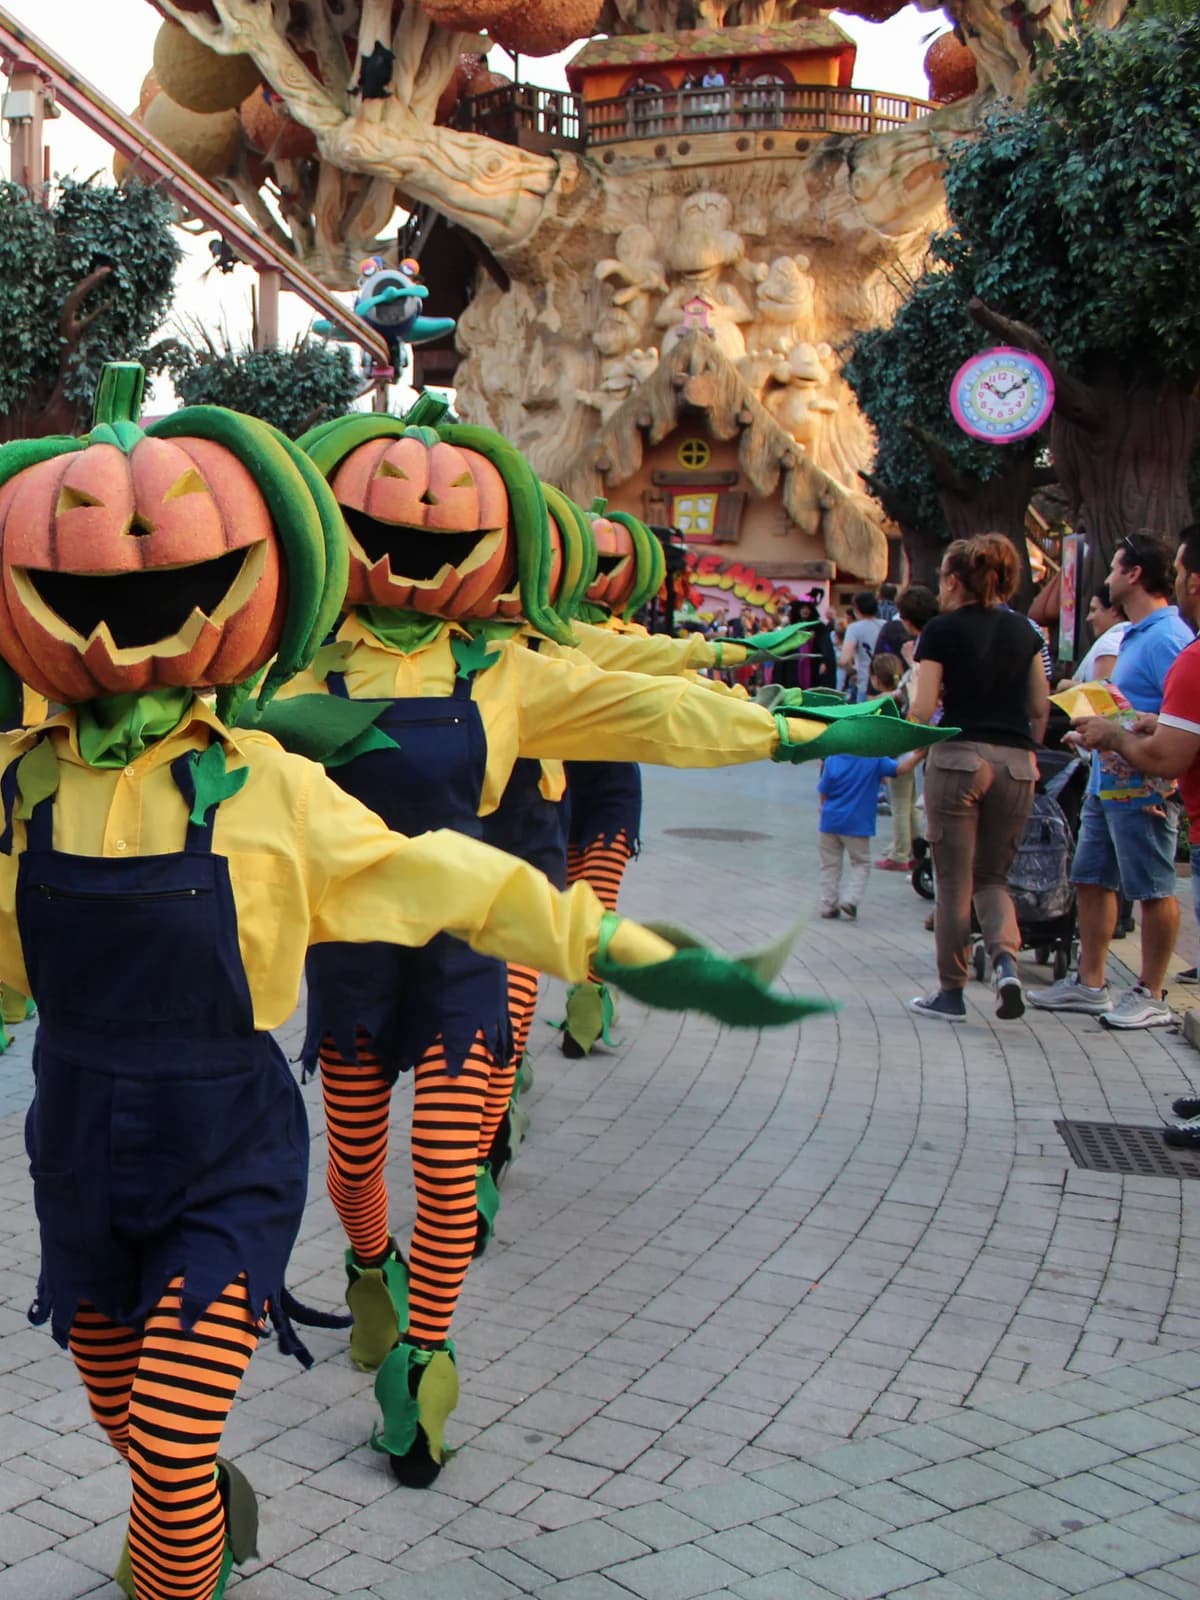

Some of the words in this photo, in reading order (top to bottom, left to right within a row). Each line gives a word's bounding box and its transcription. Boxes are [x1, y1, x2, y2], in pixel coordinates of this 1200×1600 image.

[998, 372, 1008, 381] 12
[978, 391, 984, 399] 9
[1018, 390, 1025, 399] 3
